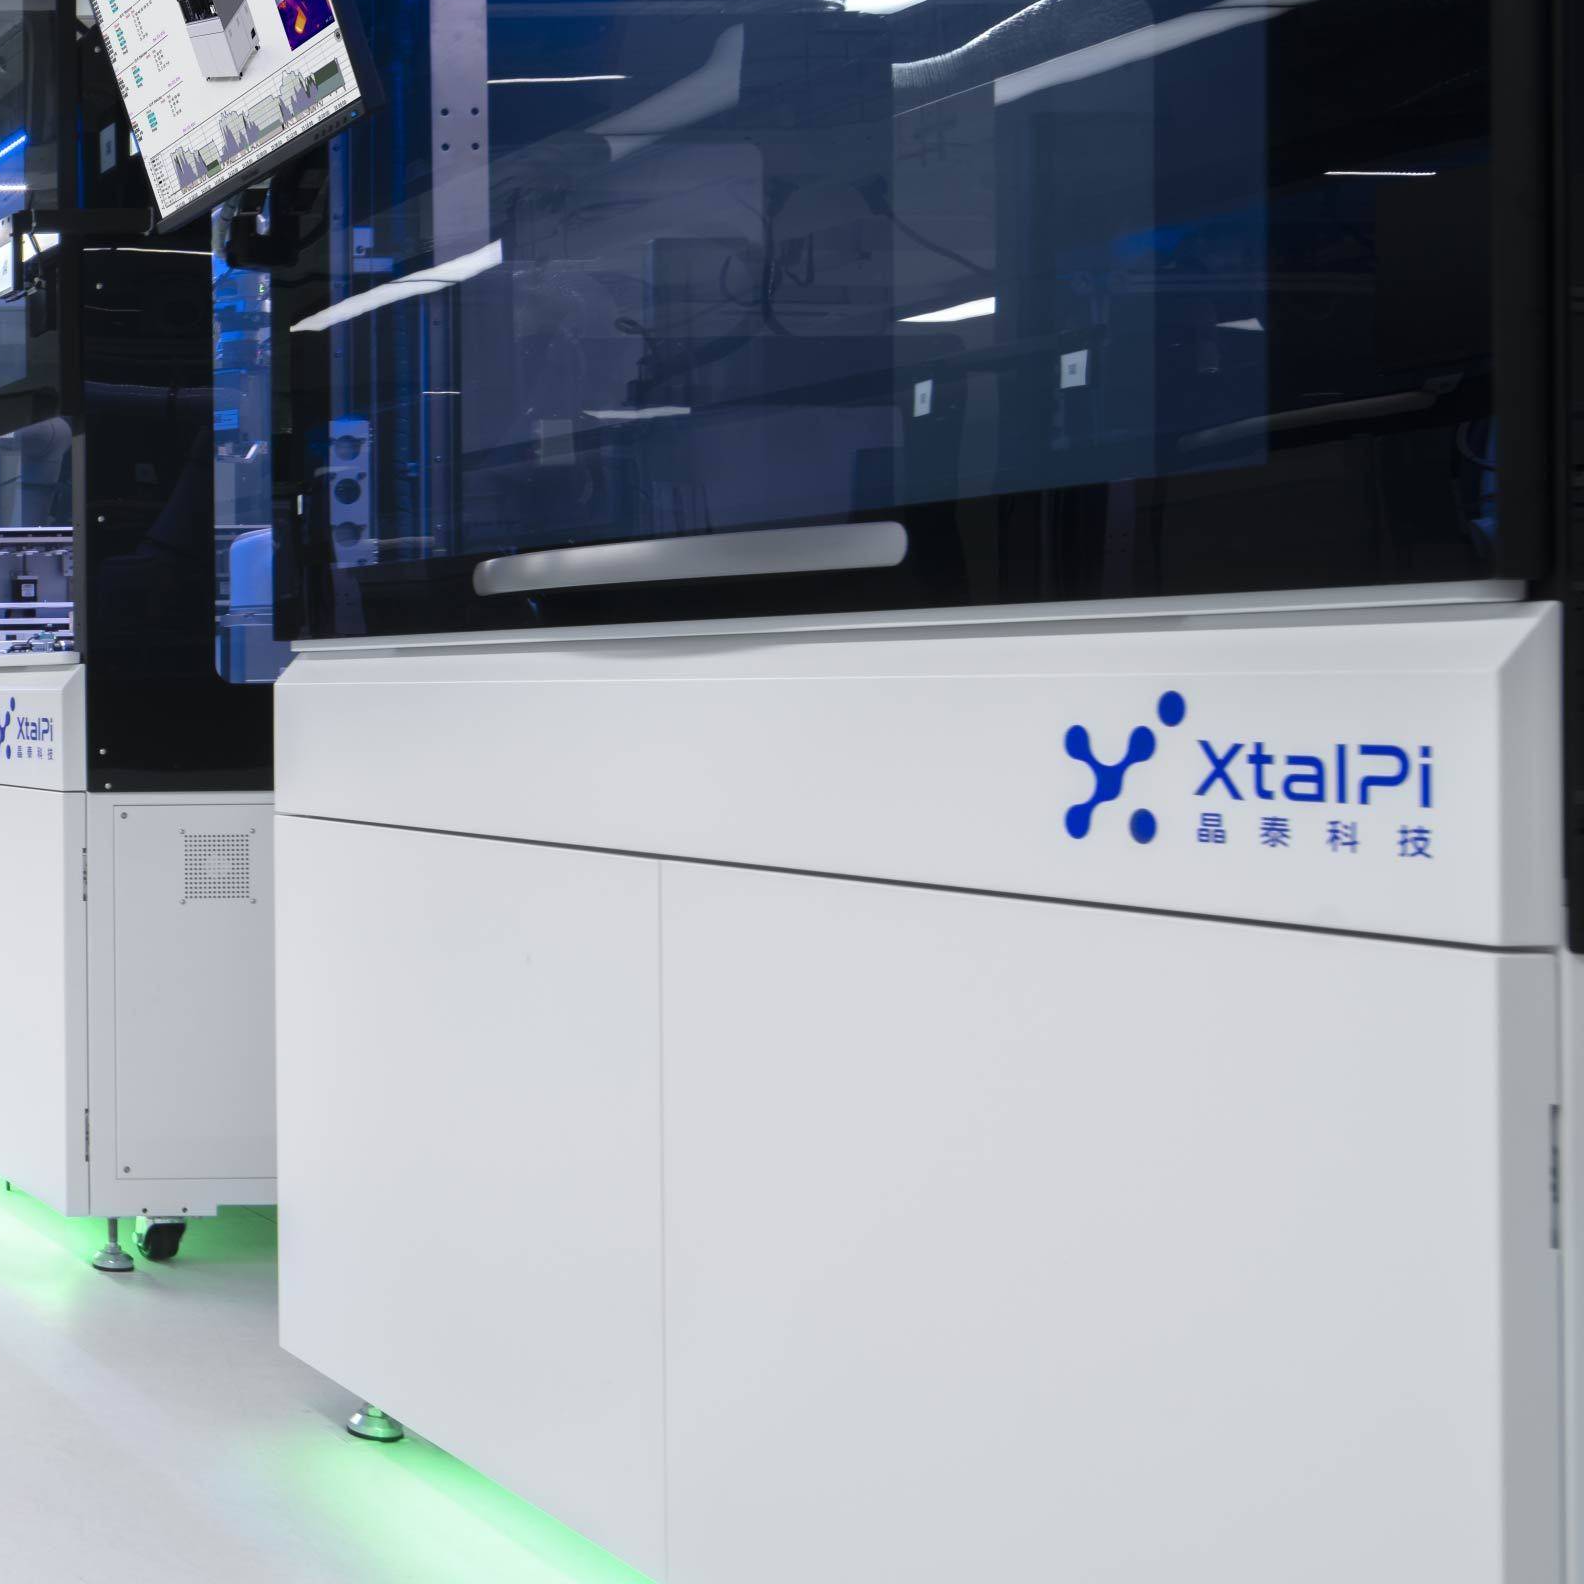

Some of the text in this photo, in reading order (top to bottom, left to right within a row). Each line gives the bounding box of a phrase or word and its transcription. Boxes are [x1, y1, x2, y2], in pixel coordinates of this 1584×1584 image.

[16, 716, 54, 742] XtalPi
[1193, 739, 1434, 808] XtalPi
[1196, 812, 1434, 860] 晶泰科技
